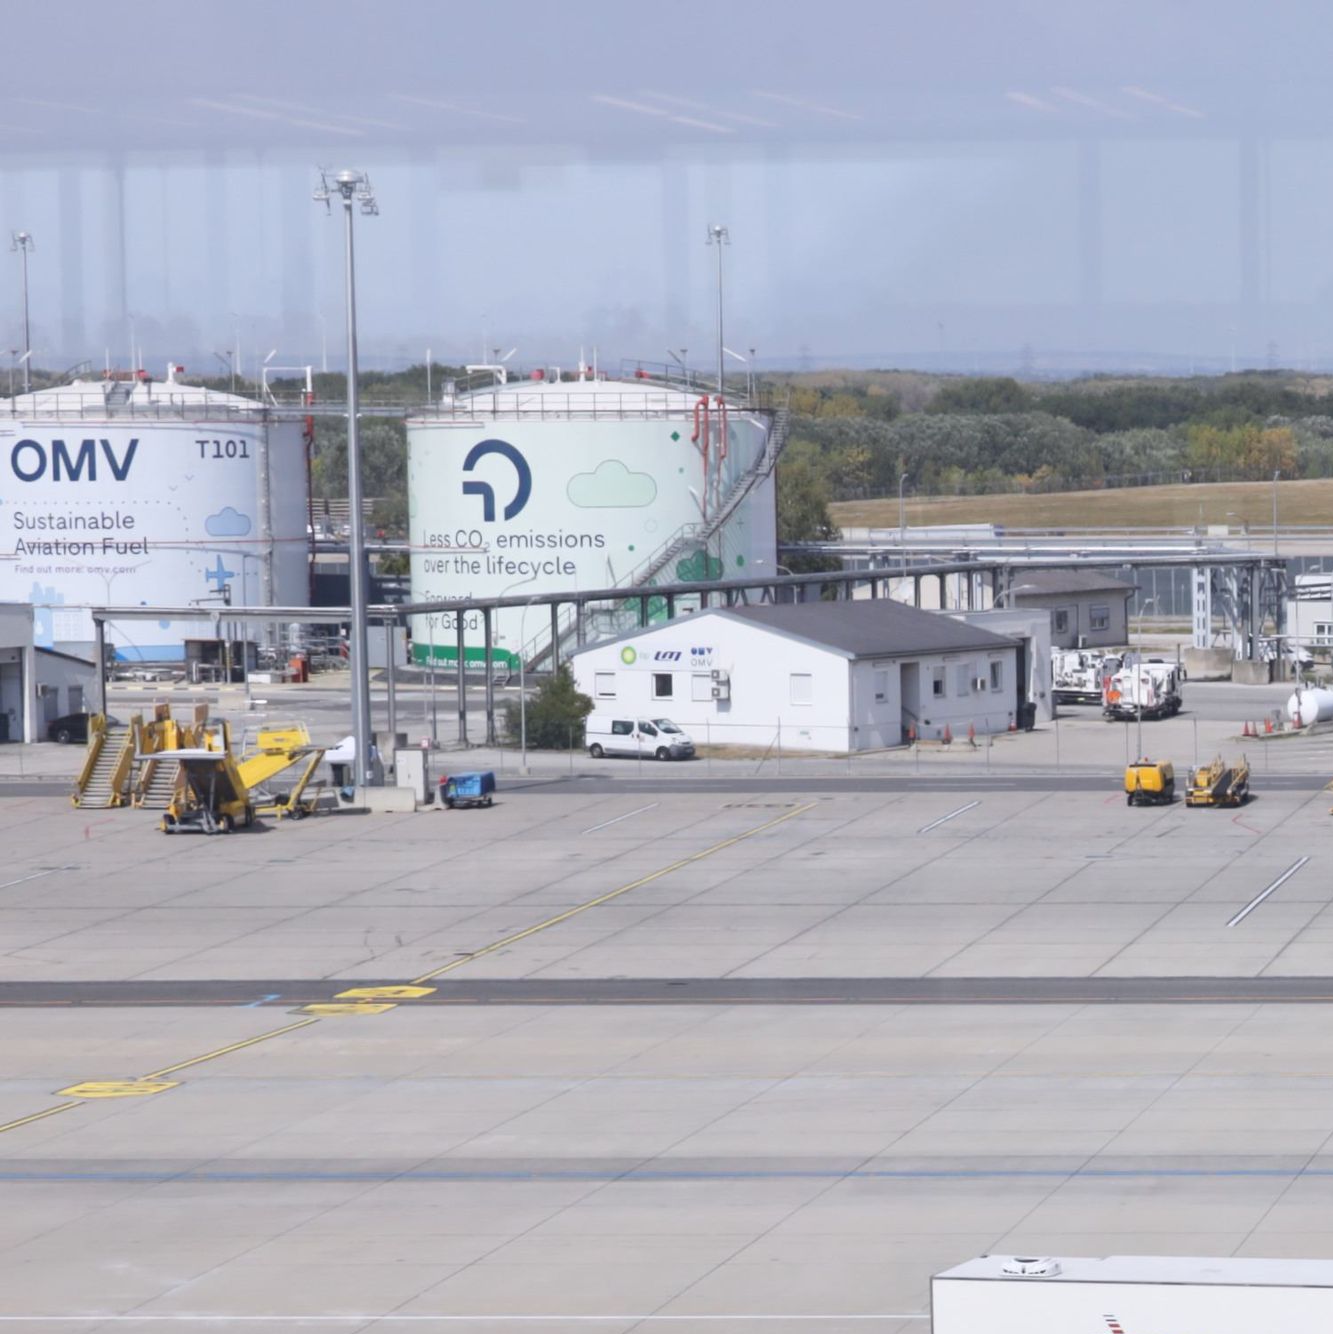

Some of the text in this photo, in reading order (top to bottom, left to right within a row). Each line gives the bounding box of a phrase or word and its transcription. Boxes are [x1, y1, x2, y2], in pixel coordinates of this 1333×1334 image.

[195, 439, 250, 459] T101
[10, 438, 140, 483] OMV
[13, 511, 136, 530] Sustainable
[14, 537, 150, 556] Aviation Fuel
[423, 529, 451, 549] Less
[496, 529, 606, 549] emissions
[424, 555, 576, 581] over the lifecycle
